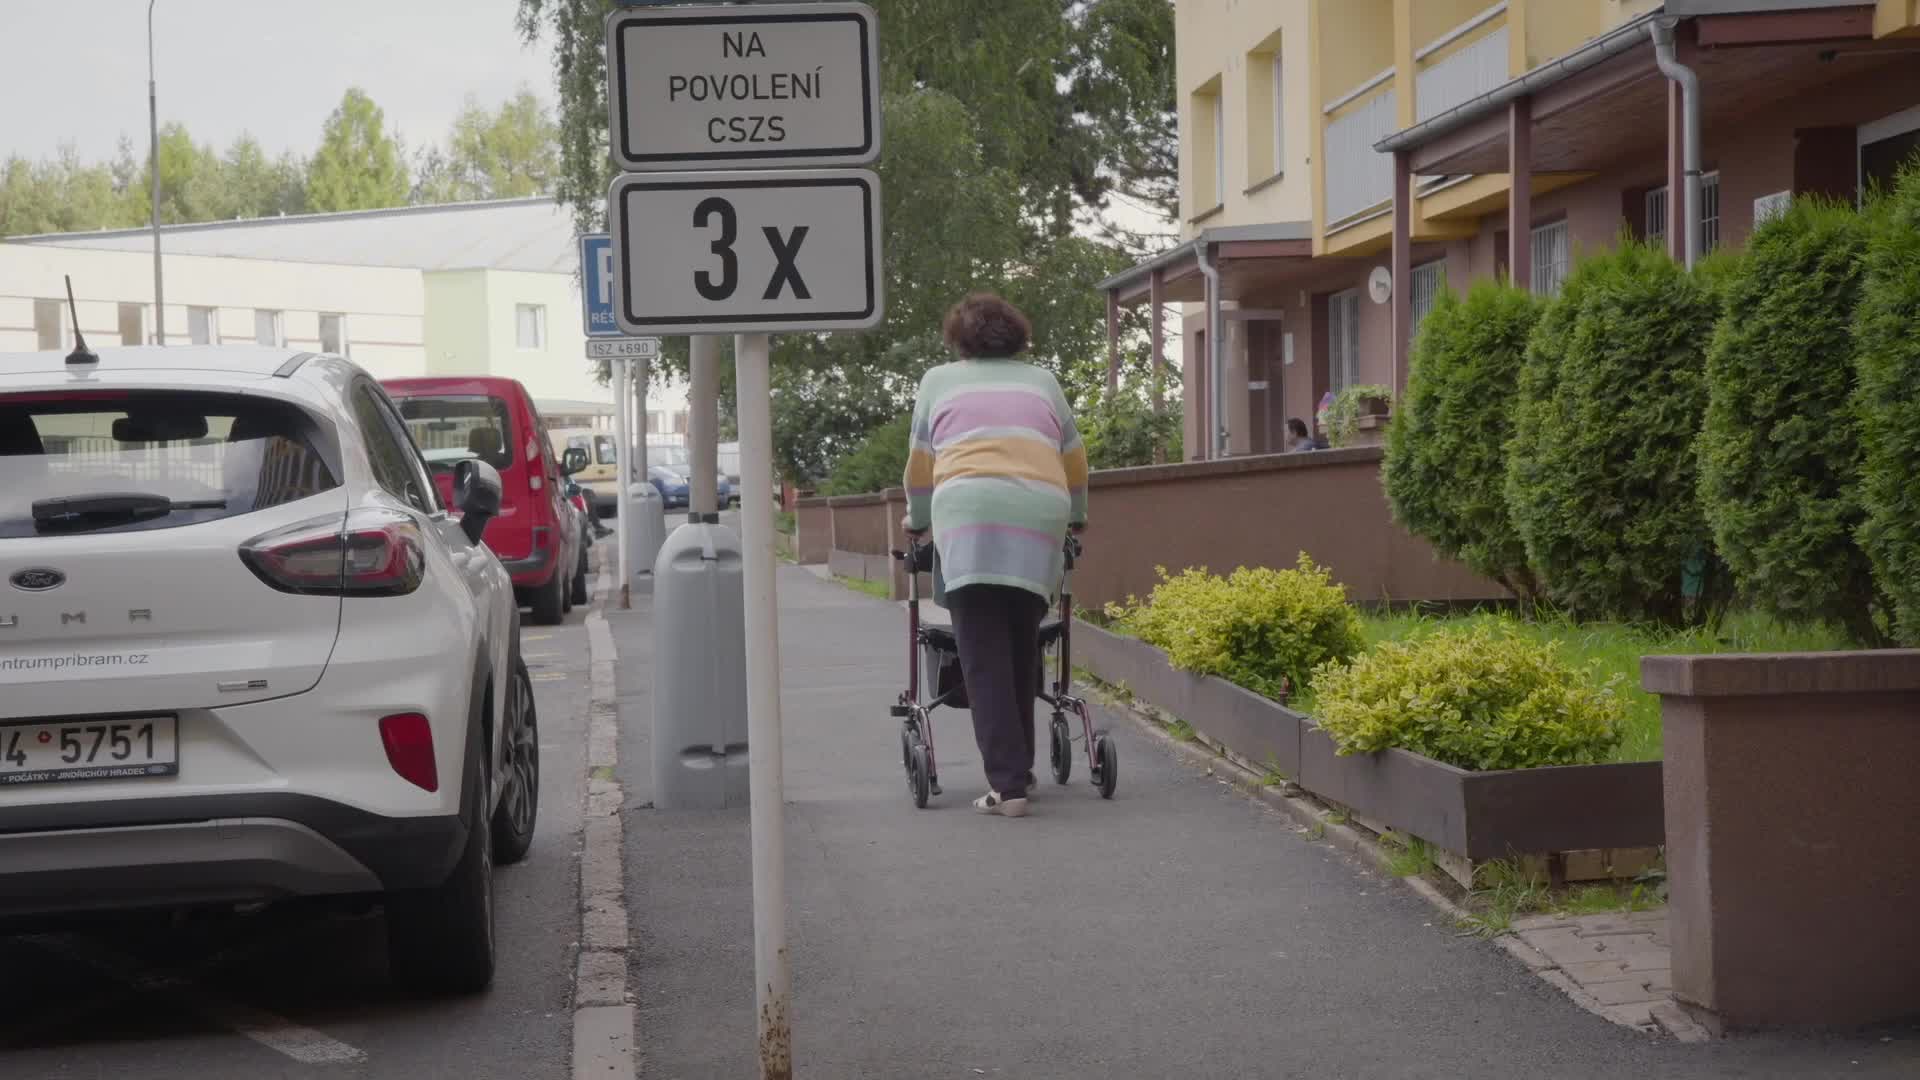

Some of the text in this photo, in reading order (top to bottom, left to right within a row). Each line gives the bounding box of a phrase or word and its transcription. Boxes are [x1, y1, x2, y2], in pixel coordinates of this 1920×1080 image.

[722, 31, 766, 58] NA
[669, 66, 823, 102] POVOLENÍ
[707, 116, 786, 143] CSZS
[692, 196, 738, 301] 3
[593, 343, 649, 355] 1SZ 4690
[0, 652, 150, 671] ntrumpribram.cz
[60, 724, 154, 764] 5751
[110, 767, 145, 777] HRADEC
